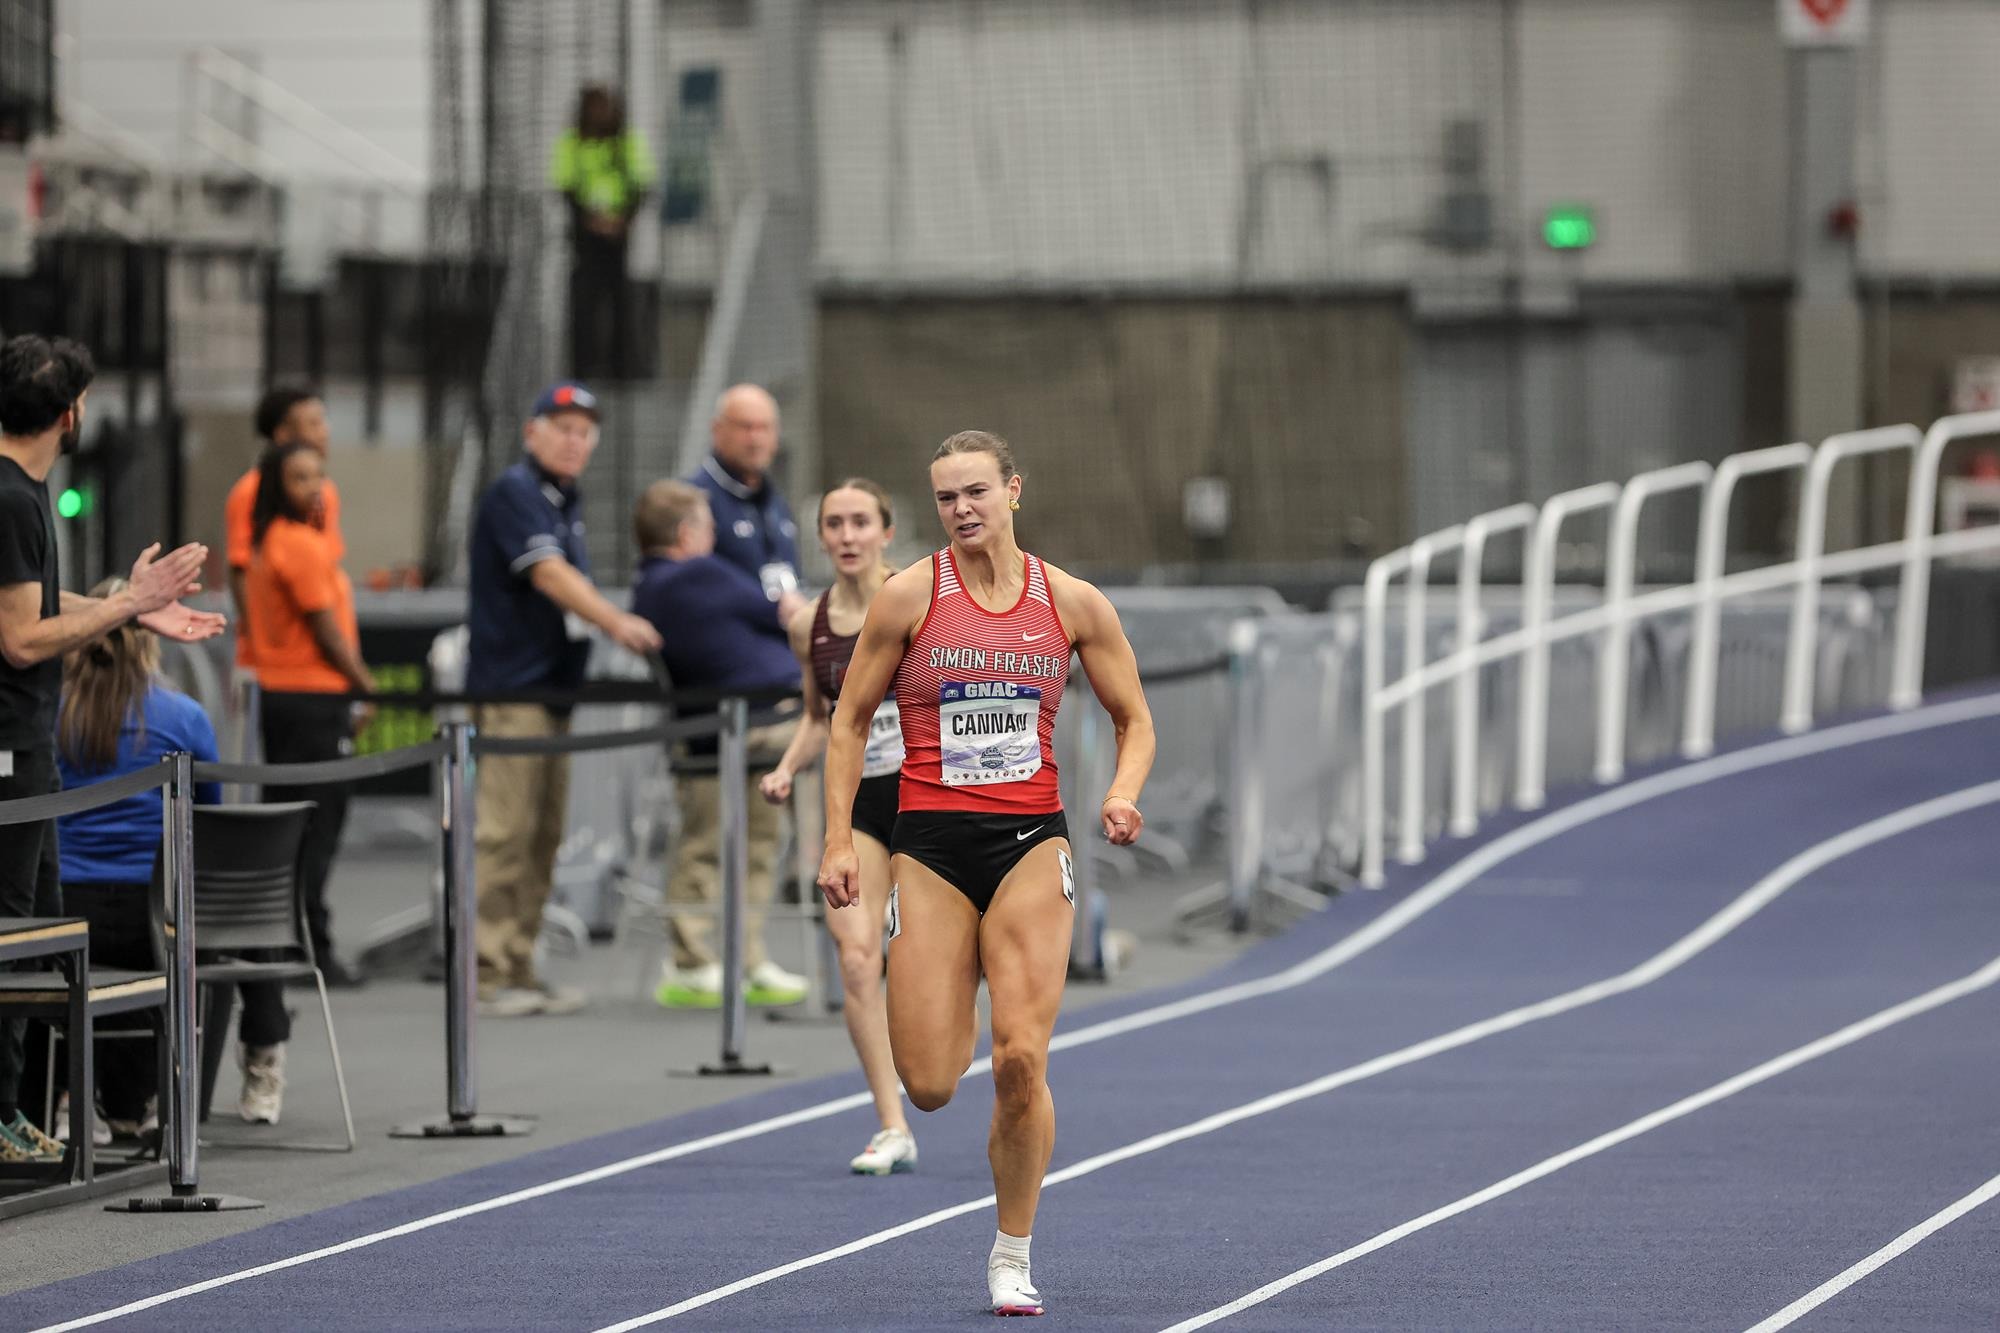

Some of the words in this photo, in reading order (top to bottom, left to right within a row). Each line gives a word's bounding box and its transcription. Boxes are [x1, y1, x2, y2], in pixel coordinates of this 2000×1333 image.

[929, 647, 986, 670] SIMON
[993, 651, 1060, 678] FRASER
[964, 682, 1018, 698] GNAC
[952, 713, 1028, 736] CANNAN
